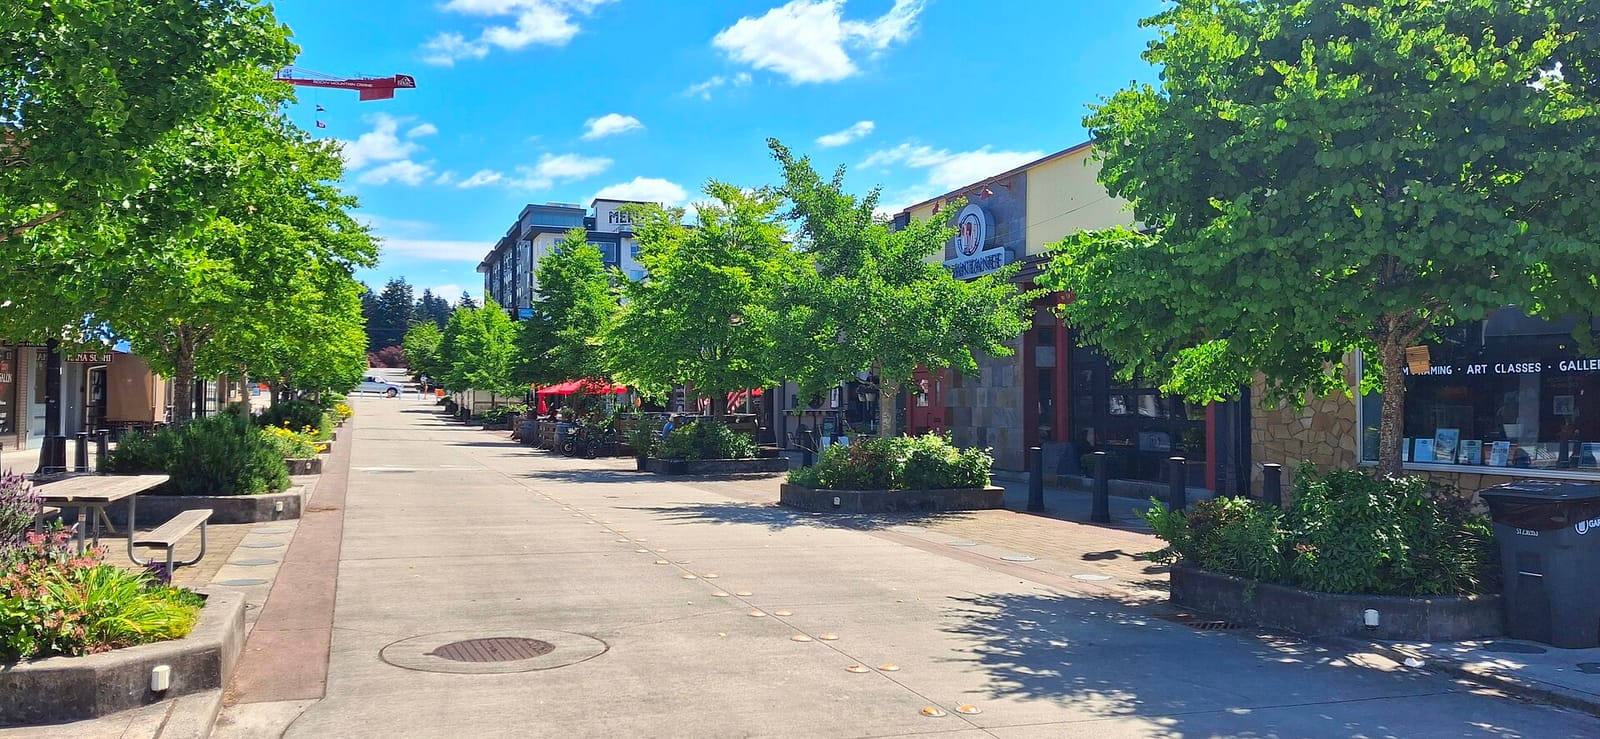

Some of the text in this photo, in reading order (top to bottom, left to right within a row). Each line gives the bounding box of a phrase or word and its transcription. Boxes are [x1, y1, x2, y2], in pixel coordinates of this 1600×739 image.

[88, 353, 112, 362] SUHI
[1466, 364, 1488, 375] ART
[1494, 362, 1542, 374] CLASSES
